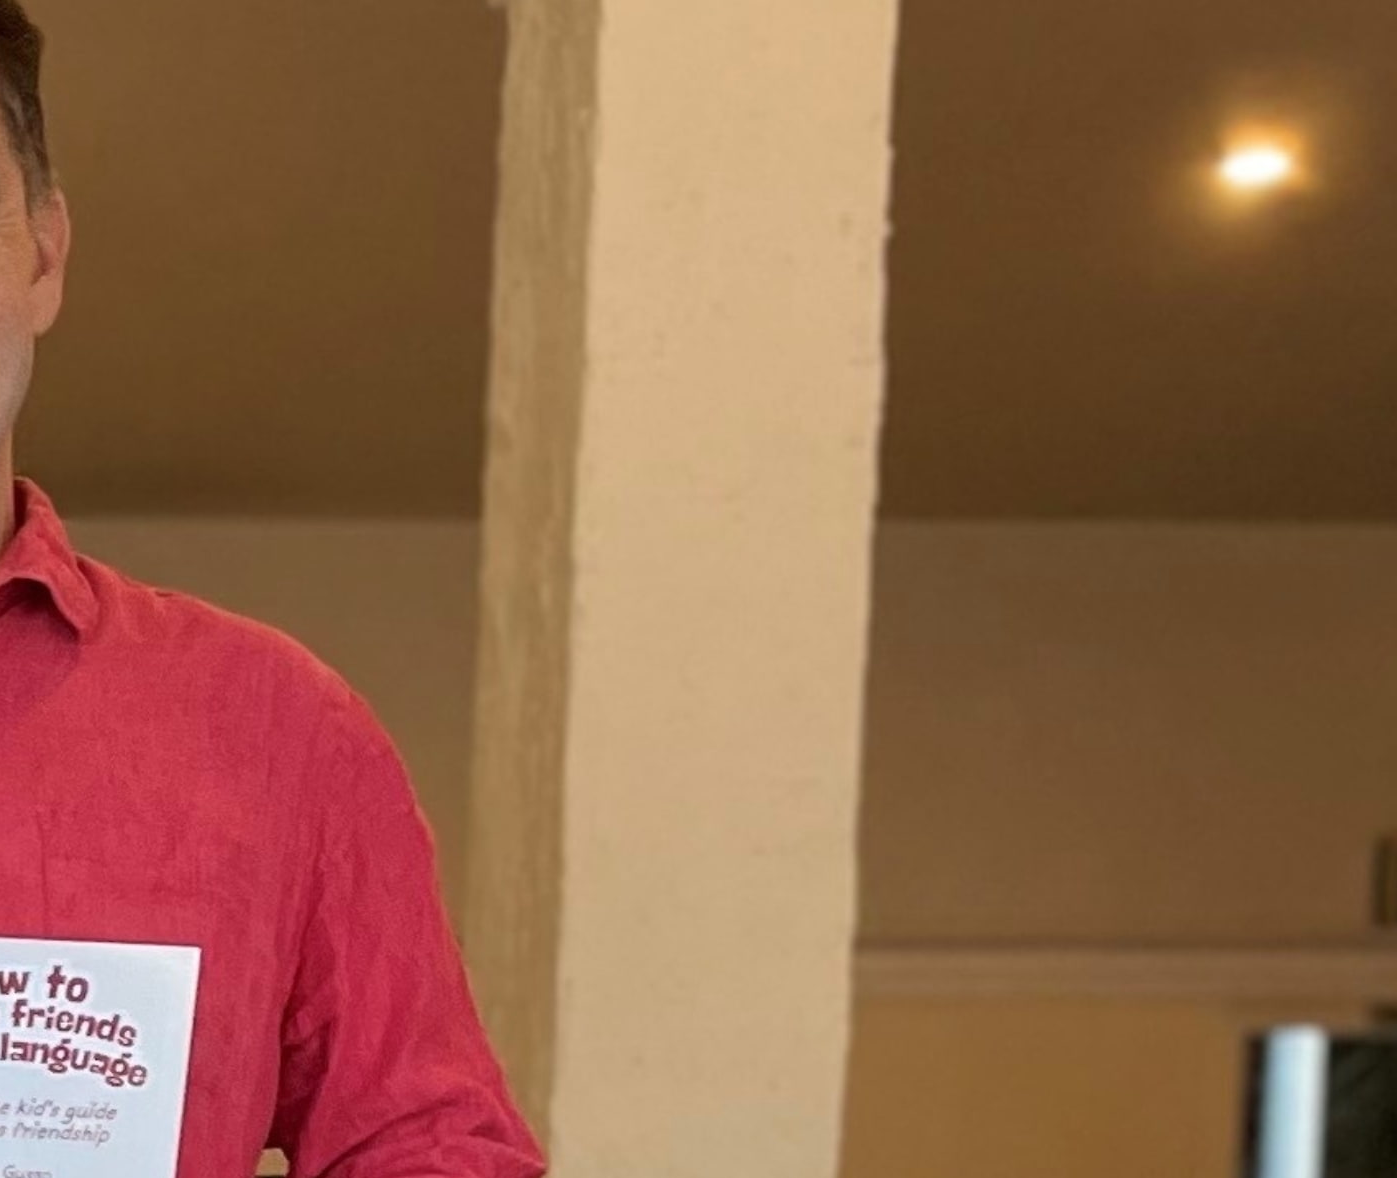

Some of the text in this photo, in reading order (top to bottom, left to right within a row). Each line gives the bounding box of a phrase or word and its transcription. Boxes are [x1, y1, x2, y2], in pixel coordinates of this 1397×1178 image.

[46, 965, 89, 1002] to
[10, 1000, 138, 1047] friends
[0, 1034, 147, 1088] language
[16, 1097, 61, 1117] kid's
[62, 1101, 118, 1125] guide
[12, 1121, 111, 1148] friendship
